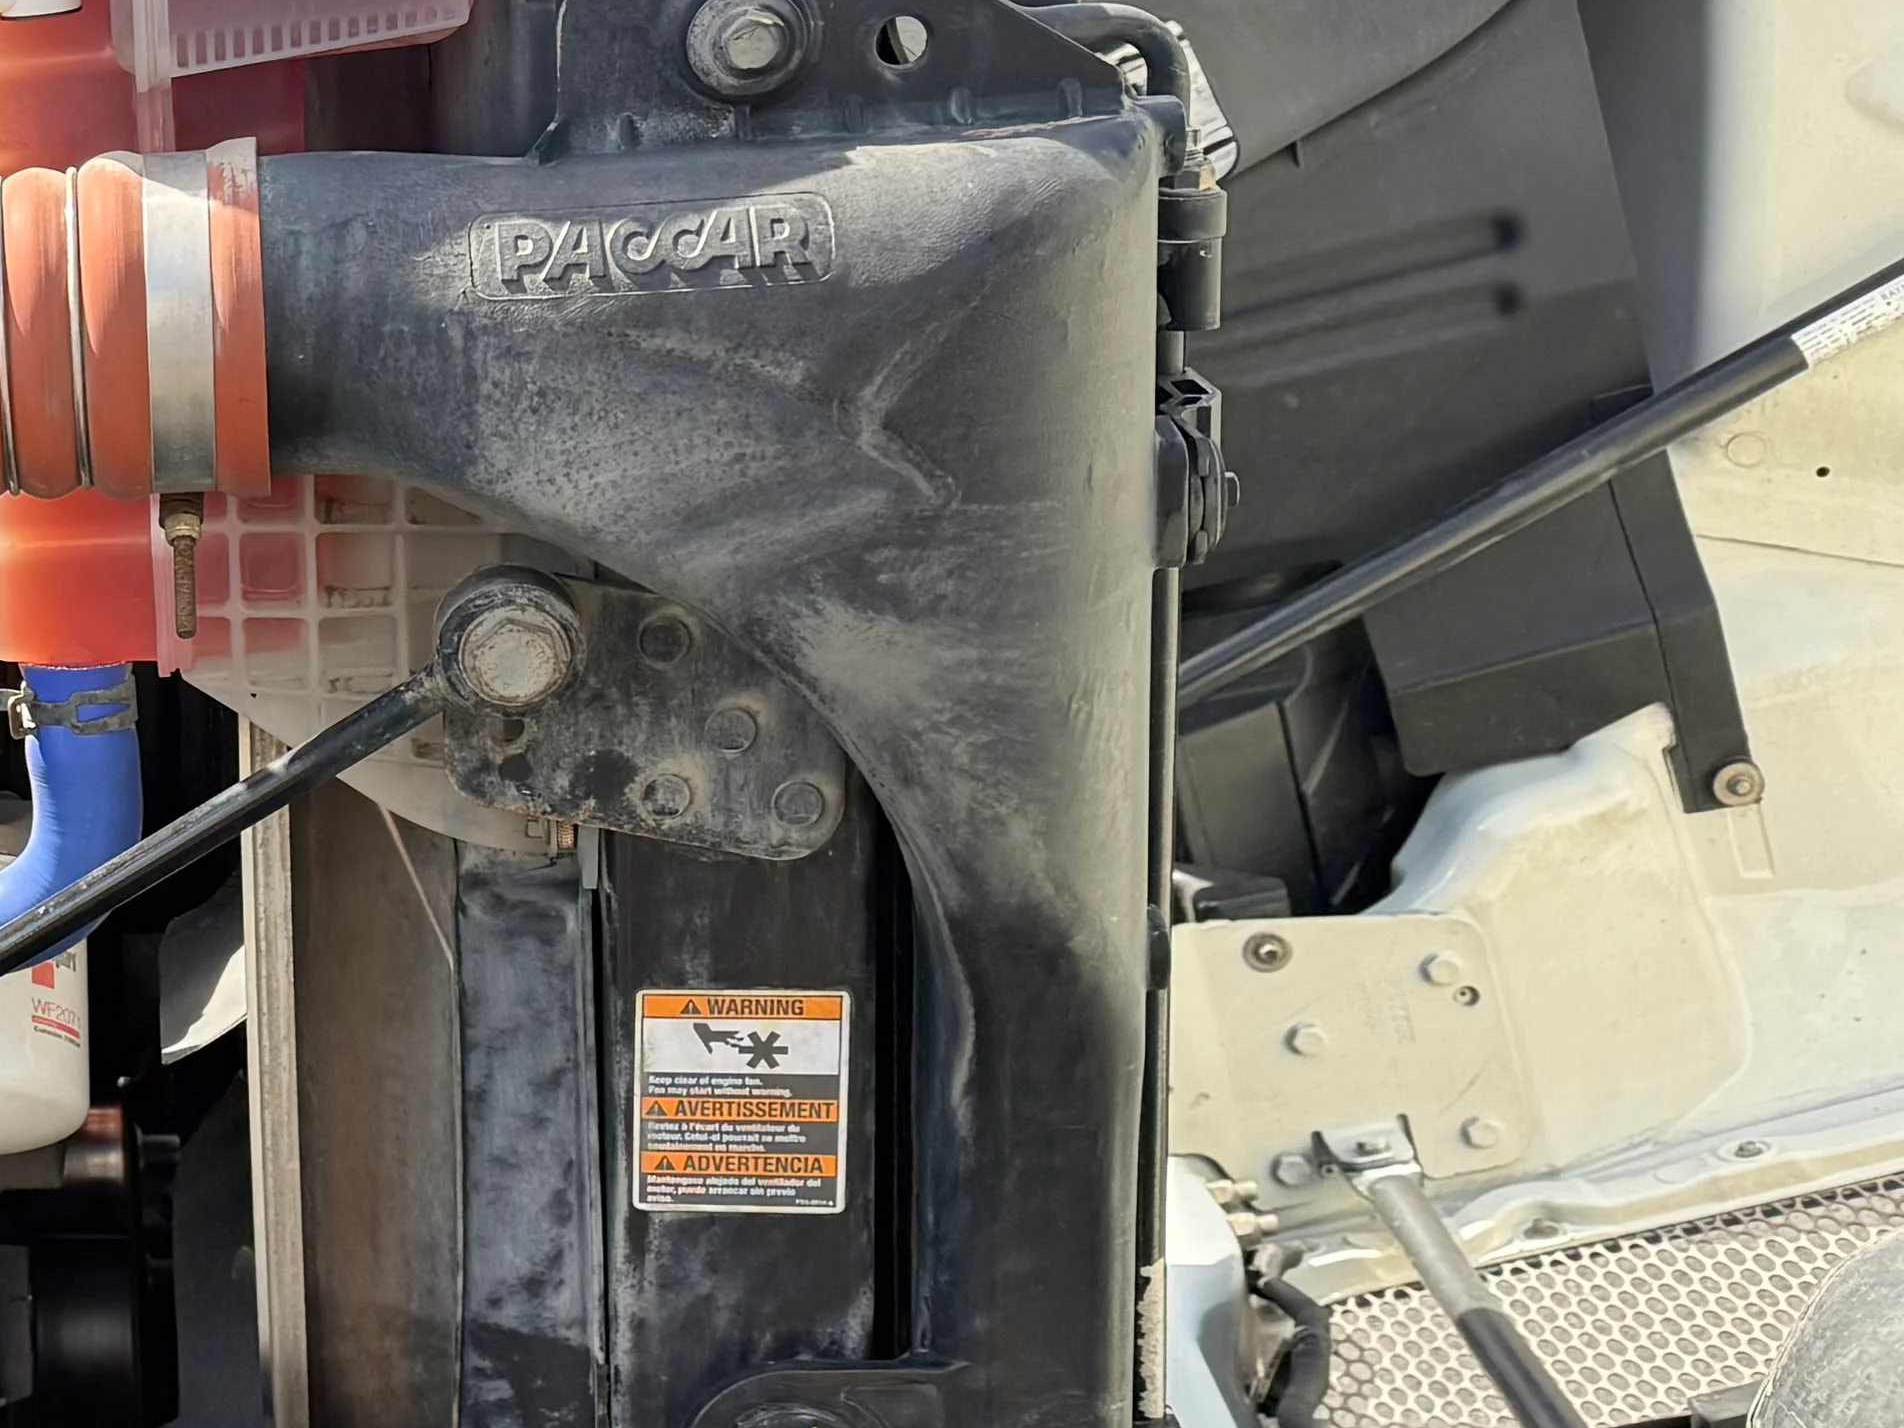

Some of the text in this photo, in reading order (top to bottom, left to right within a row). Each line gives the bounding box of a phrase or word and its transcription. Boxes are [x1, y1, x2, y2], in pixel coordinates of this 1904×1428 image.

[493, 203, 815, 286] PACCAR
[707, 998, 804, 1017] WARNING
[648, 1075, 763, 1087] Keep clear of engine fan.
[667, 1087, 687, 1096] may
[689, 1087, 712, 1095] start
[675, 1100, 835, 1119] AVERTISSEMENT
[683, 1155, 824, 1174] ADVERTENCIA
